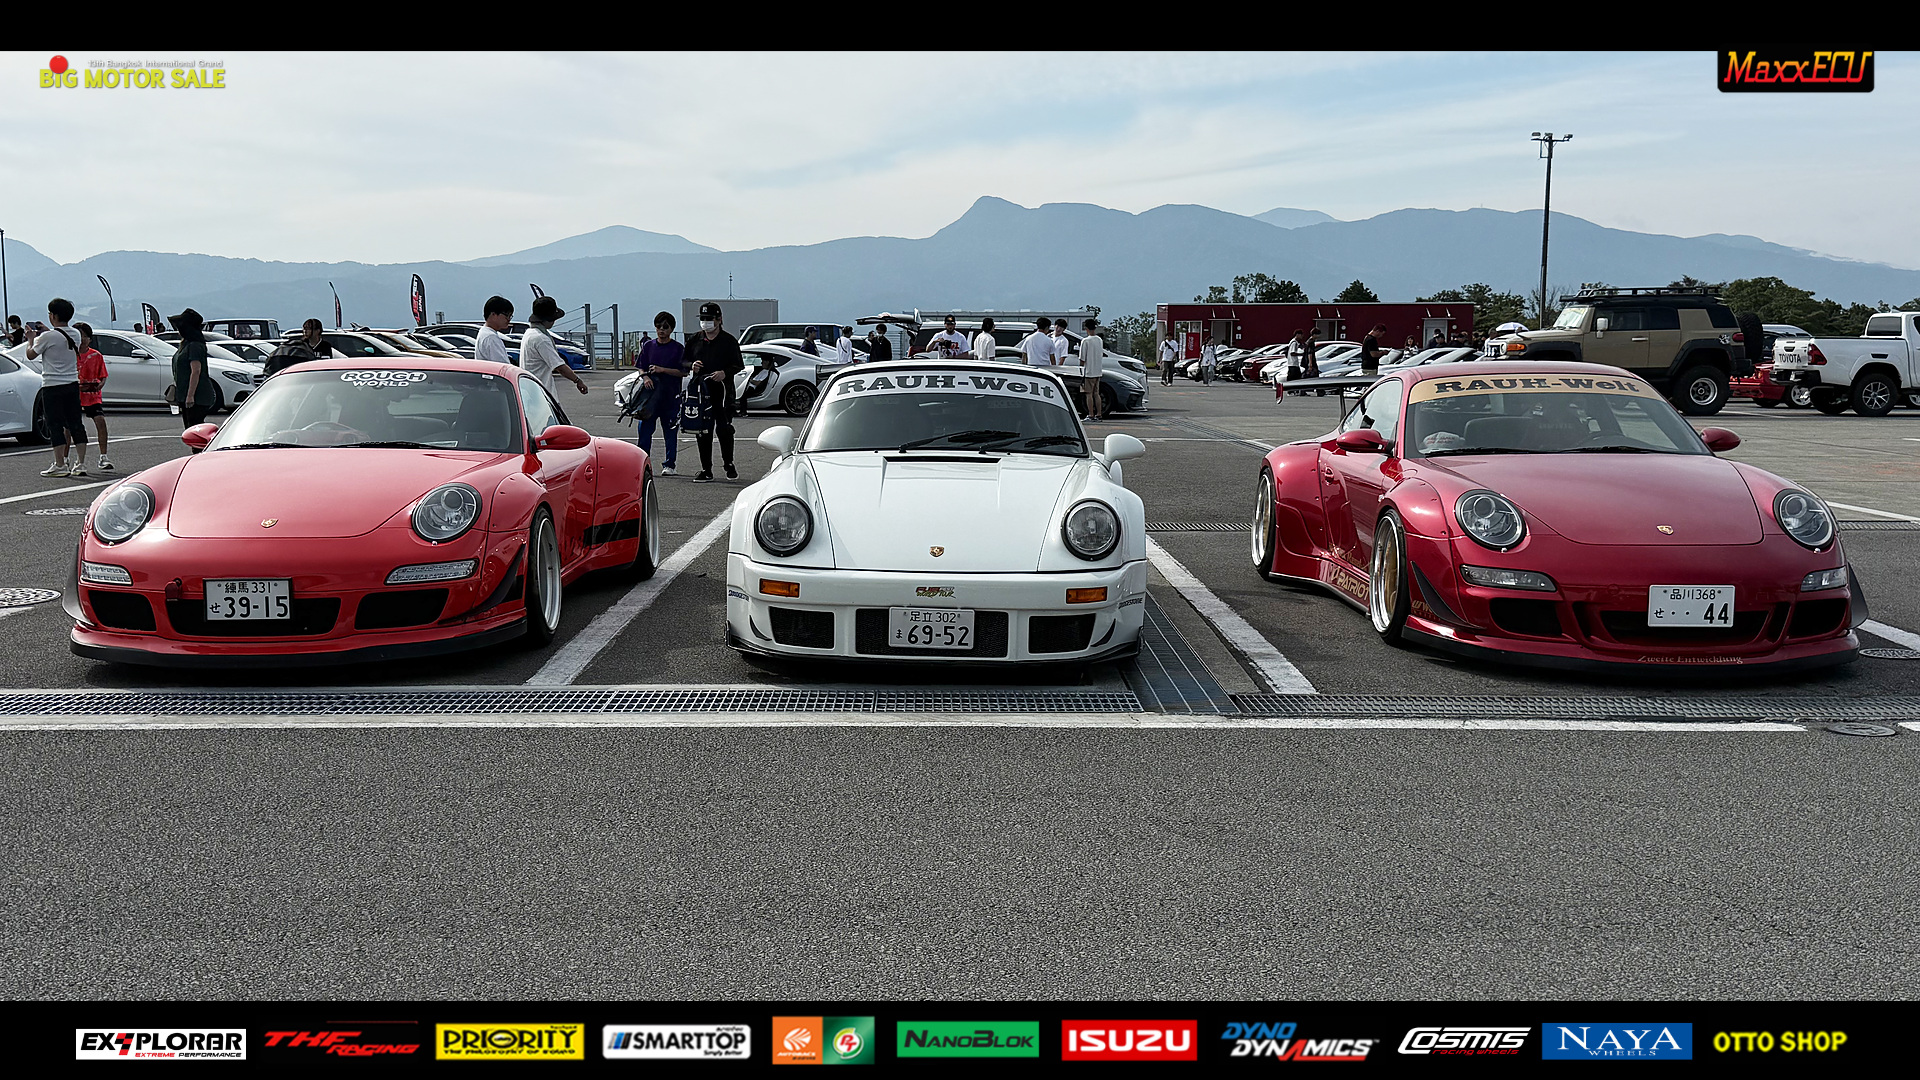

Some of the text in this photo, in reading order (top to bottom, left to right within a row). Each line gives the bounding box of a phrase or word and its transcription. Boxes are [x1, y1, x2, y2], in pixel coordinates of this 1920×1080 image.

[1778, 353, 1802, 363] TOYOTA
[342, 371, 427, 382] ROUGH
[836, 375, 1055, 399] RAUH-Welt
[1435, 378, 1640, 394] RAUH-Welt
[224, 582, 271, 594] 練馬 331
[1670, 588, 1716, 600] 品川 368
[209, 595, 288, 618] せ 39-15
[909, 611, 956, 623] 足立 302
[1653, 607, 1665, 619] せ
[907, 624, 969, 646] 69-52
[1637, 655, 1743, 666] Zweite Entwicklung
